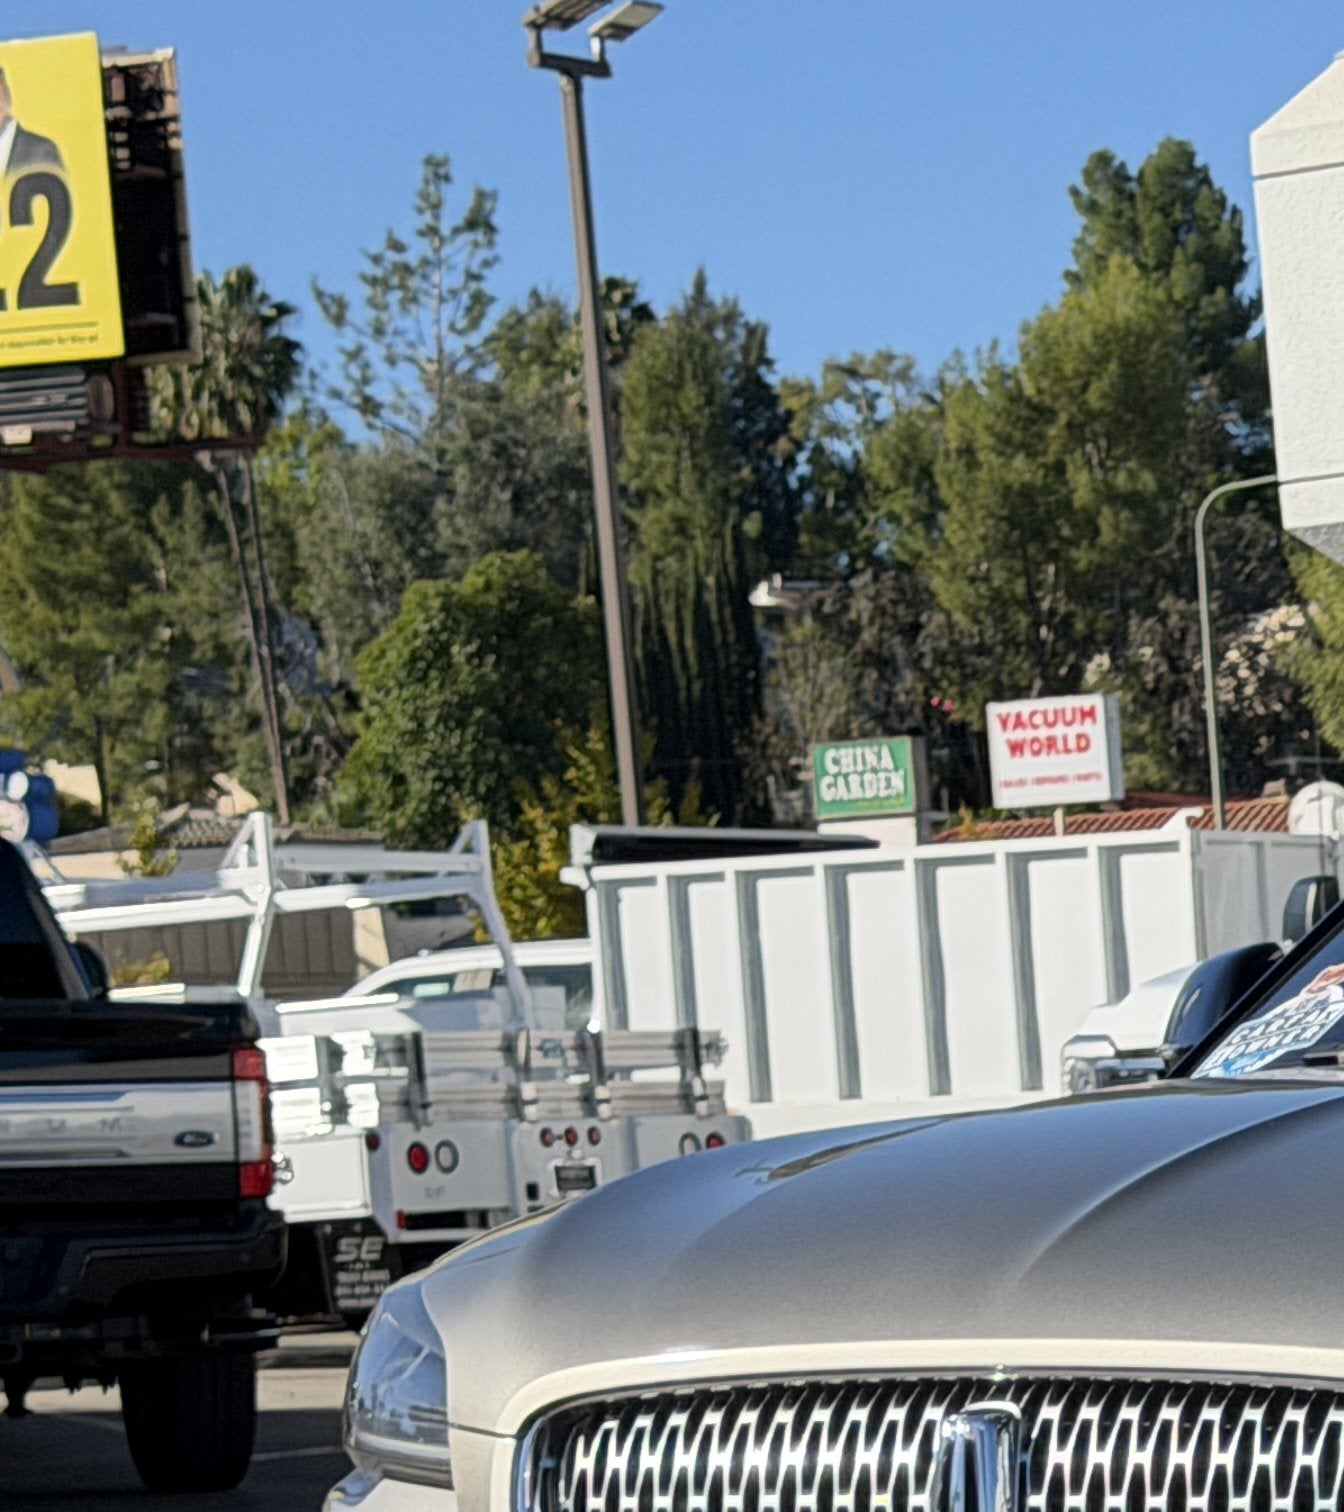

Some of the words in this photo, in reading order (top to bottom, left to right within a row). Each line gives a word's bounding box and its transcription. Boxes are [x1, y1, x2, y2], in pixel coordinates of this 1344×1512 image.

[0, 172, 81, 312] 2
[996, 704, 1098, 734] VACUUM
[824, 744, 895, 774] CHINA
[1005, 732, 1092, 759] WORLD
[820, 767, 905, 802] GARDEN
